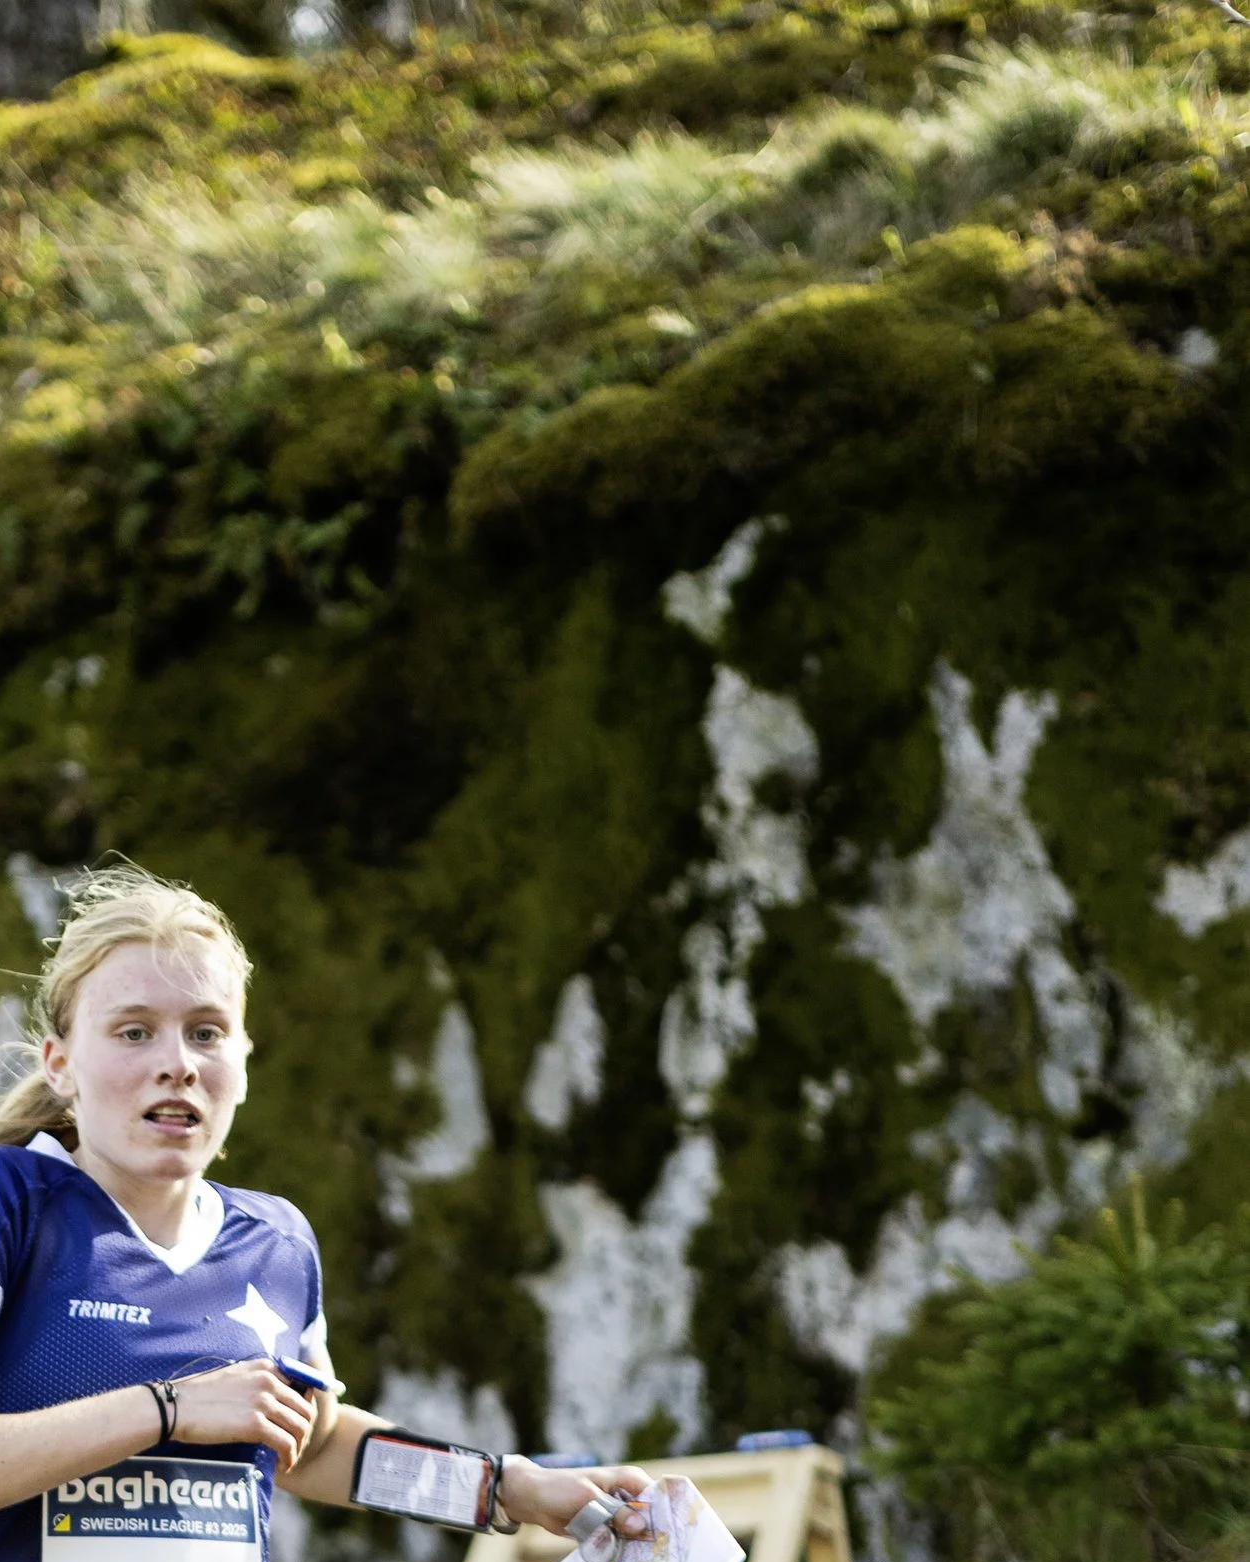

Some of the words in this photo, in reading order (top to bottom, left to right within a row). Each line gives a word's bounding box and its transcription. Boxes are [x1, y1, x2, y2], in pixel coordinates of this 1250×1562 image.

[68, 1299, 152, 1325] TRIMTEX
[80, 1517, 149, 1532] SWEDISH
[152, 1518, 203, 1534] LEAGUE
[205, 1521, 219, 1535] #3
[221, 1522, 248, 1537] 2025
